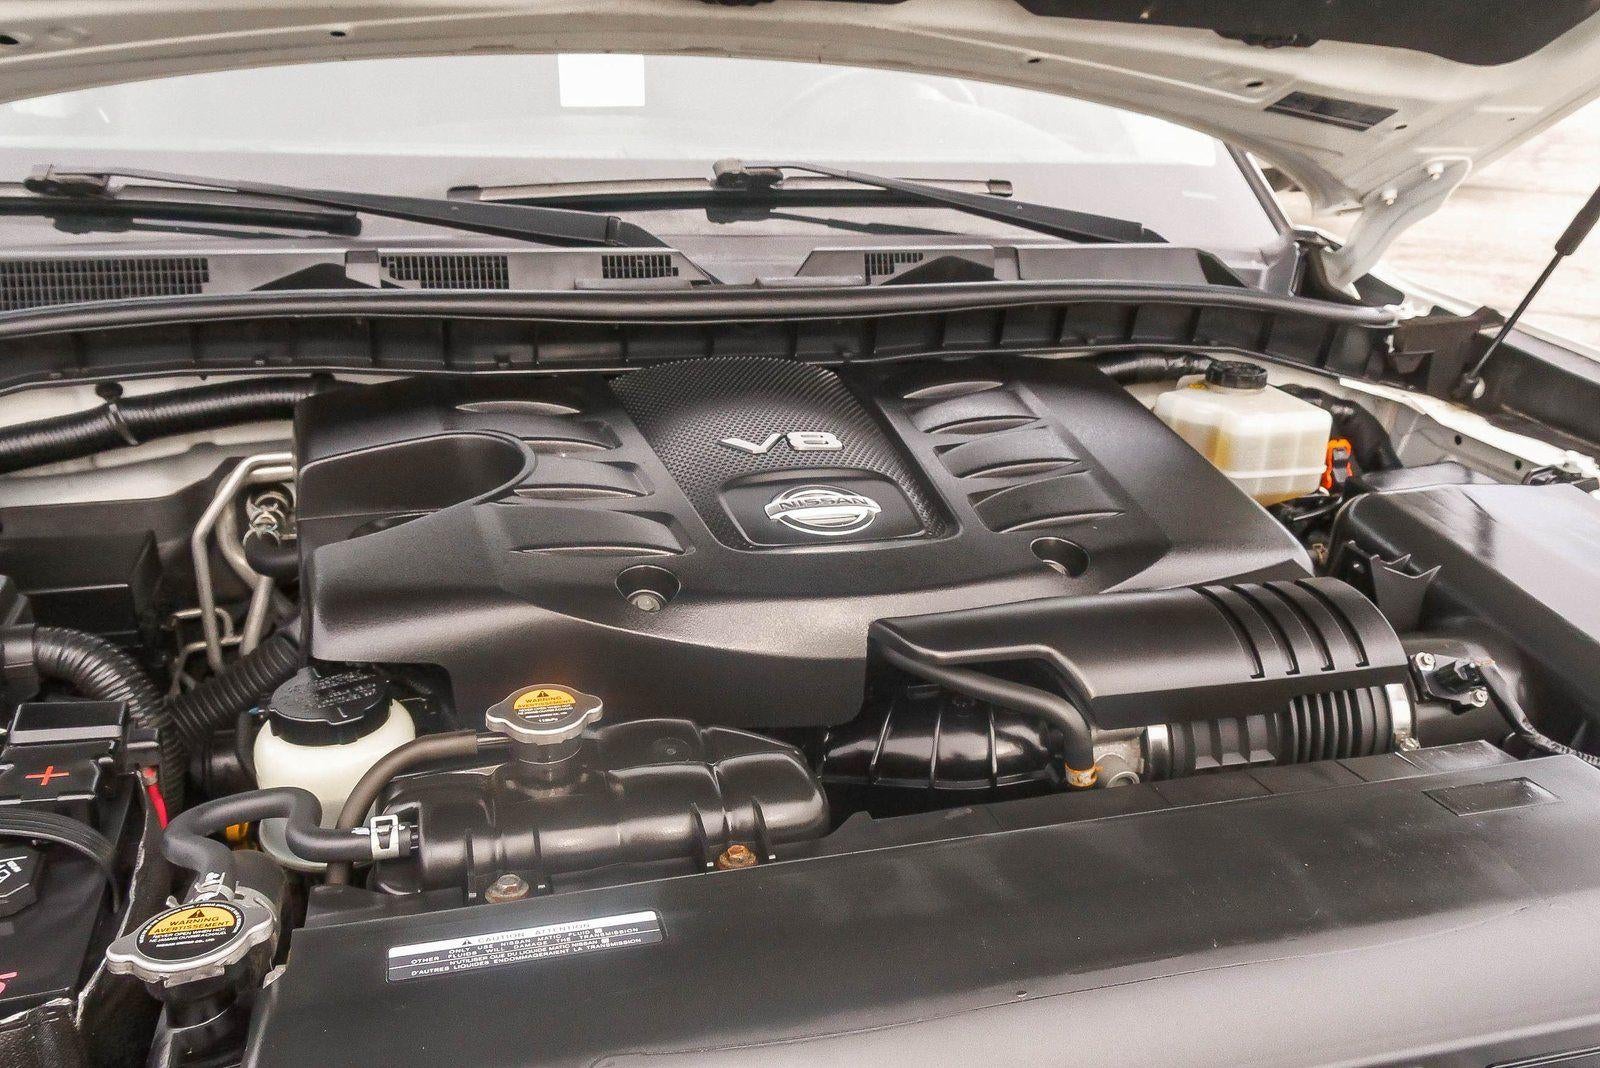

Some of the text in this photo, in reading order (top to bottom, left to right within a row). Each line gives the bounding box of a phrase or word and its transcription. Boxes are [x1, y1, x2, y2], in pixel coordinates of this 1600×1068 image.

[716, 431, 845, 455] V8
[779, 497, 870, 511] NISSAN
[154, 921, 229, 933] AVERTISSEMENT
[170, 916, 219, 926] WARNING
[449, 946, 470, 955] ONLY
[477, 943, 494, 951] USE
[500, 938, 531, 947] NISSAN
[537, 934, 562, 943] MATIC
[568, 929, 590, 938] FLUID
[478, 932, 525, 943] CAUTION
[535, 922, 590, 935] ATTENTION
[411, 956, 440, 965] OTHER
[447, 951, 478, 959] FLUIDS
[513, 940, 548, 950] DAMAGE
[556, 936, 571, 944] THE
[580, 927, 639, 939] TRANSMISSION
[489, 952, 505, 960] QUE
[519, 946, 547, 955] LIQUIDE
[548, 943, 570, 951] MATIC
[571, 939, 598, 948] NISSAN
[411, 966, 449, 976] D'AUTRES
[453, 961, 490, 970] LIQUIDES
[493, 949, 569, 964] ENDOMMAGERAIENT
[586, 938, 642, 950] TRANSMISSION
